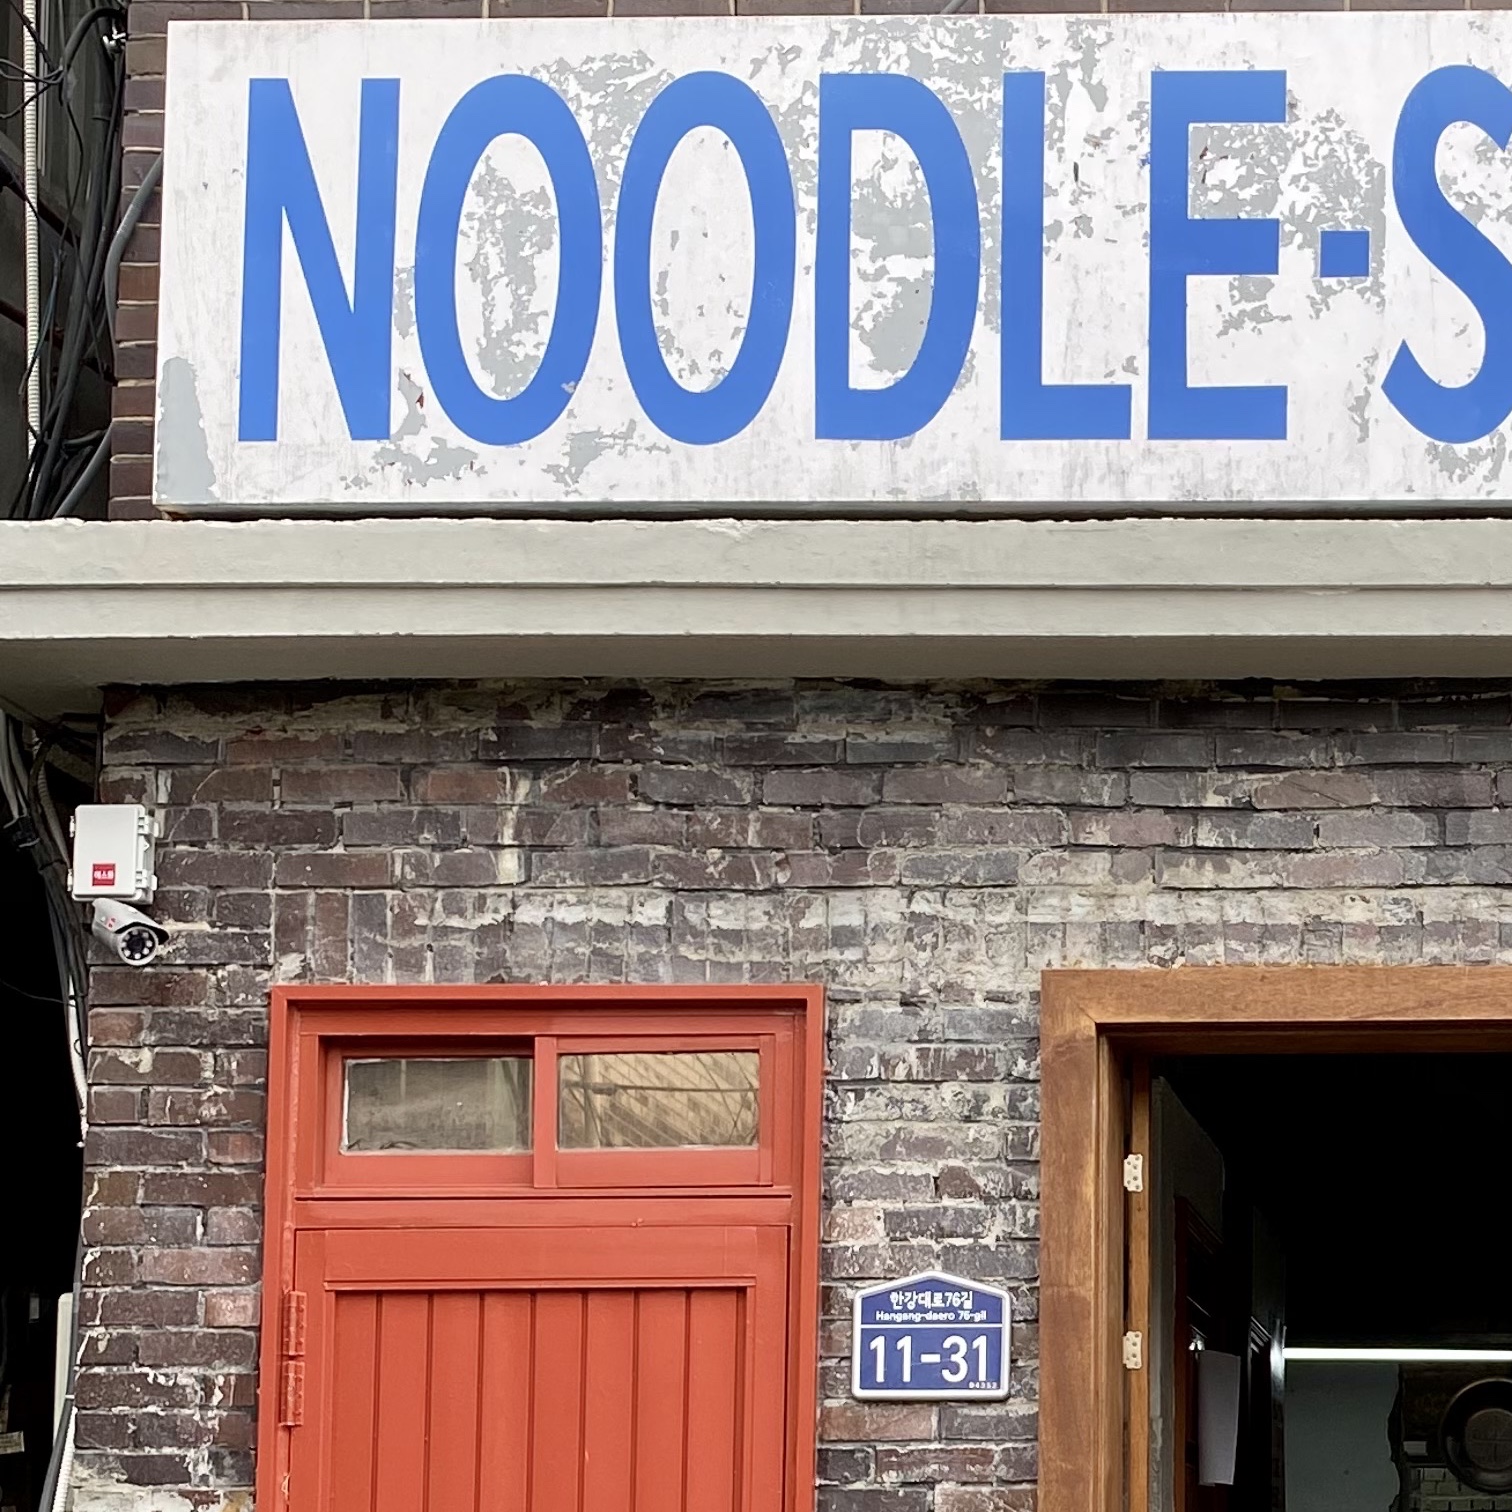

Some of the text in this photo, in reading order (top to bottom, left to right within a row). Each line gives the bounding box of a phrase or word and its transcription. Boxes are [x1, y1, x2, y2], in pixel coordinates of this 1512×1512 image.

[889, 1290, 973, 1310] 한강대로76길
[876, 1310, 987, 1323] Hangang-daero 76-gil
[868, 1335, 988, 1384] 11-31
